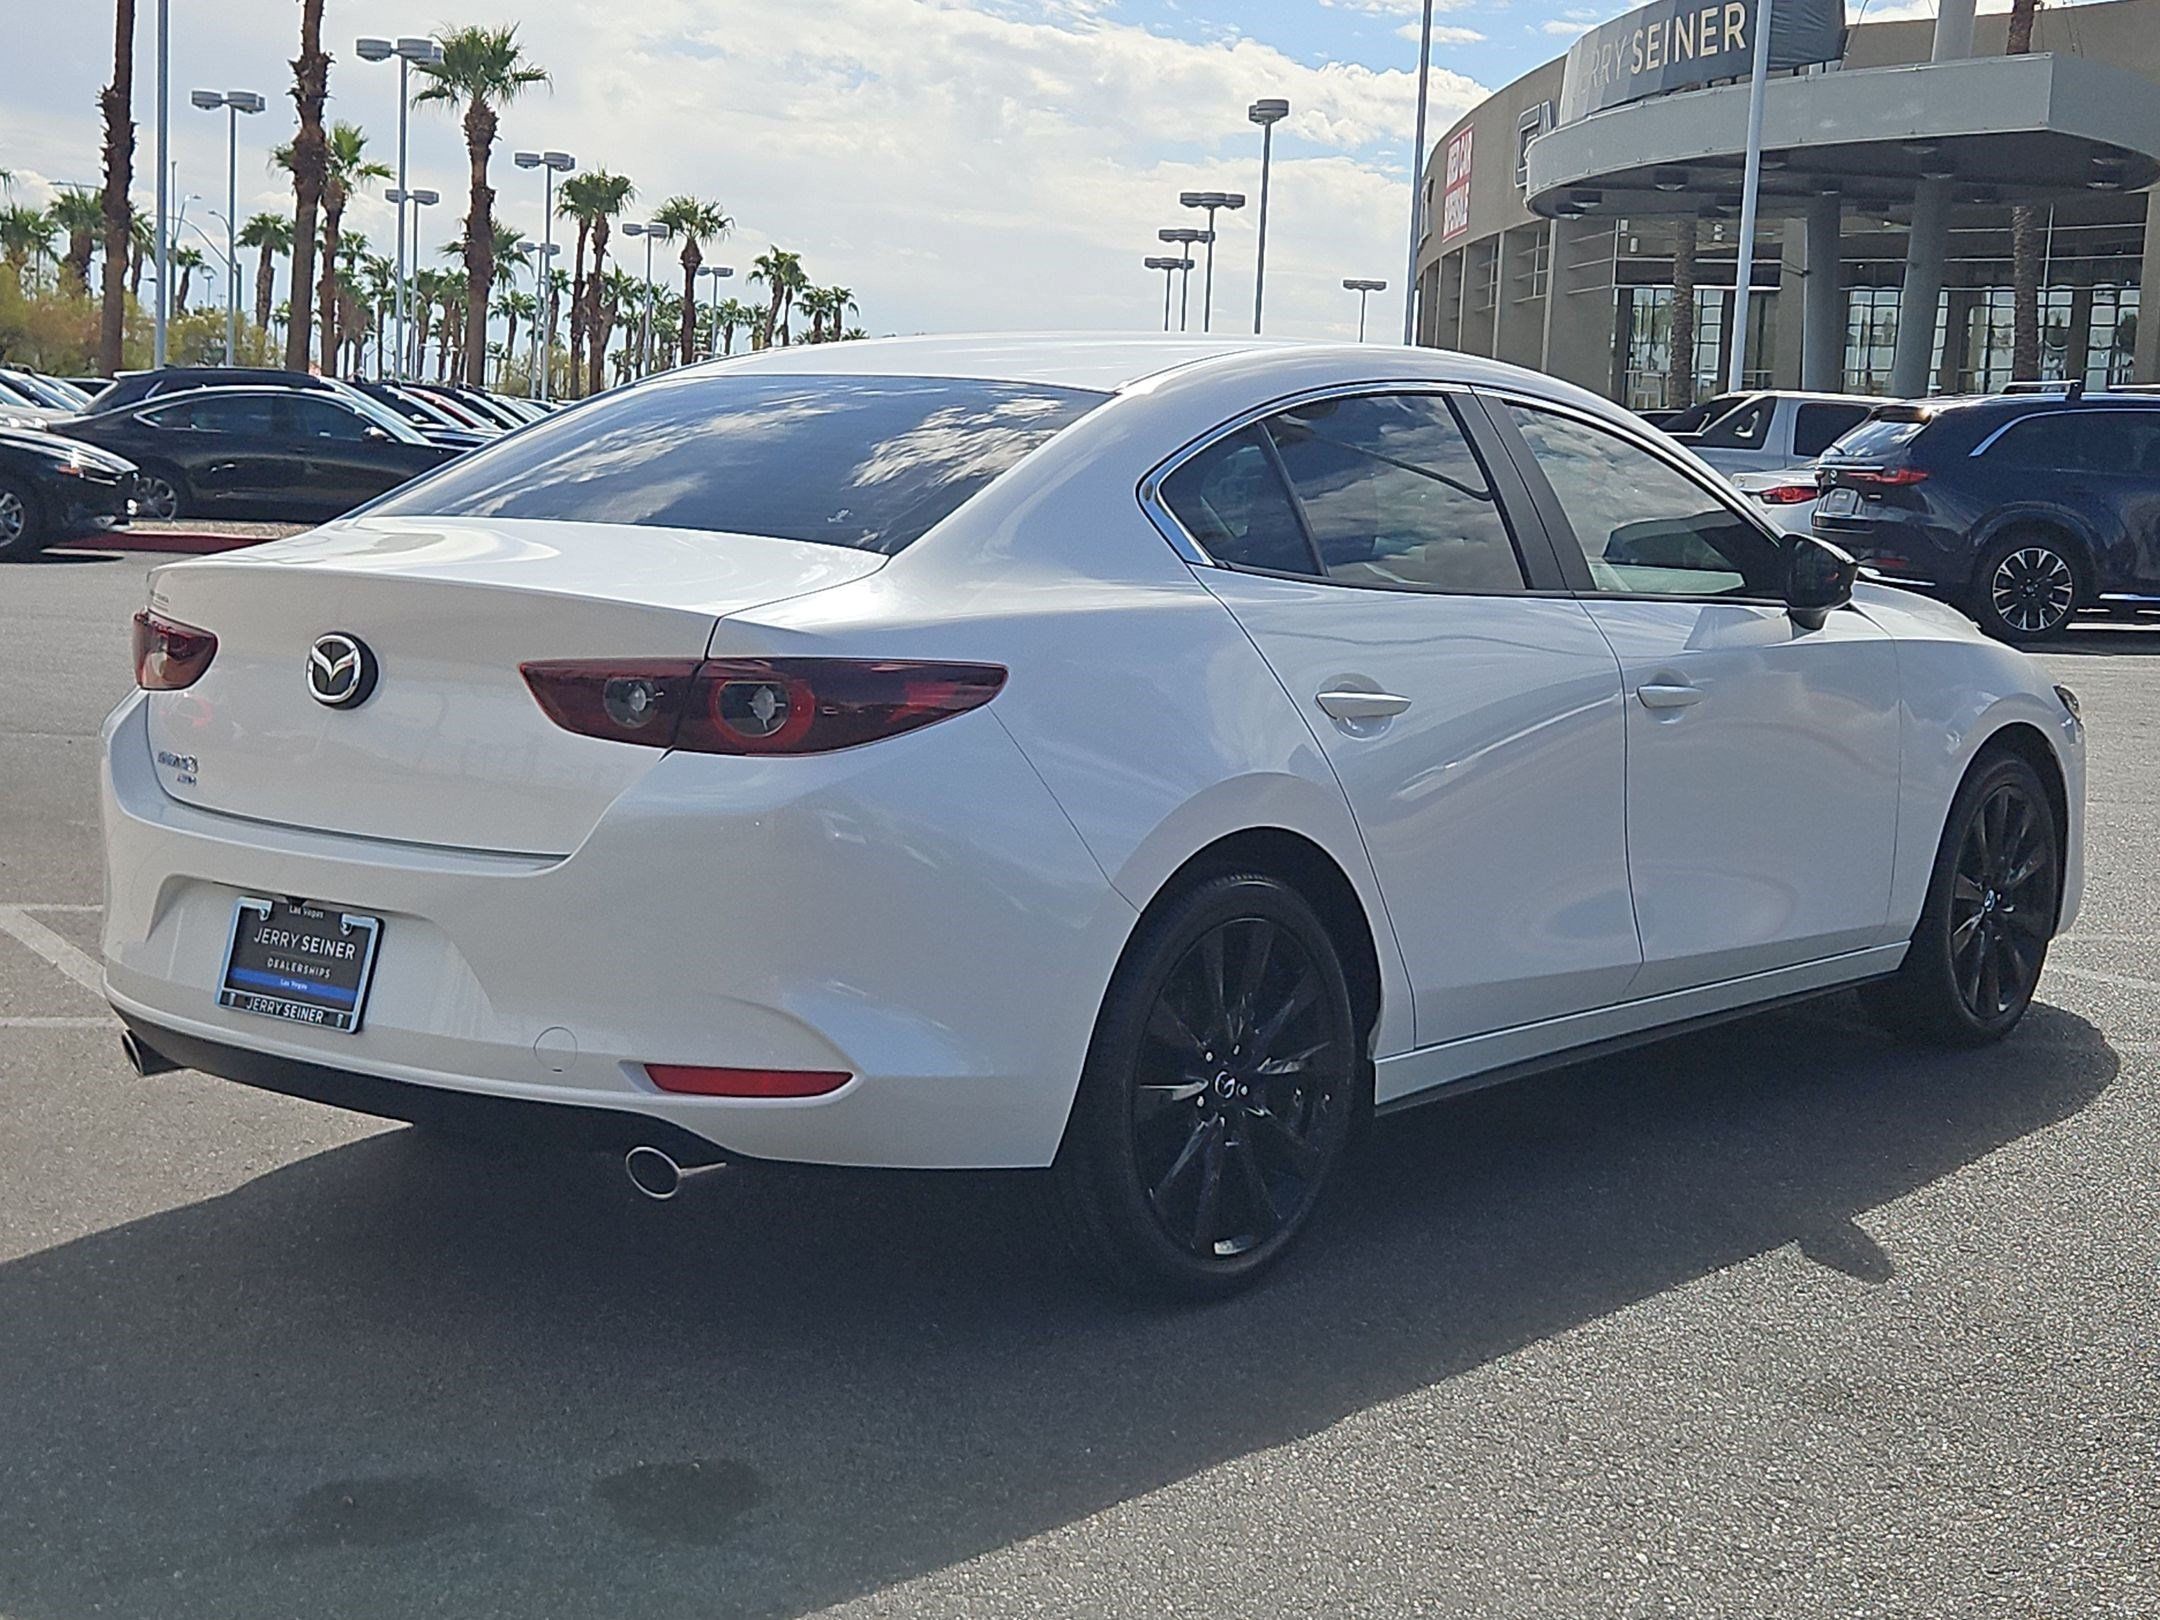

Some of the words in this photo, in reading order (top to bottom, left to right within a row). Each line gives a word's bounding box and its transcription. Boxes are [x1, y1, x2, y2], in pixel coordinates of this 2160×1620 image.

[1630, 1, 1747, 75] SEINER
[289, 904, 302, 915] Las
[302, 906, 324, 919] Vegas
[253, 927, 300, 949] JERRY
[300, 935, 356, 960] SEINER
[266, 957, 331, 979] DEALERSHIPS
[246, 997, 283, 1015] JERRY
[282, 1004, 324, 1024] SEINER
